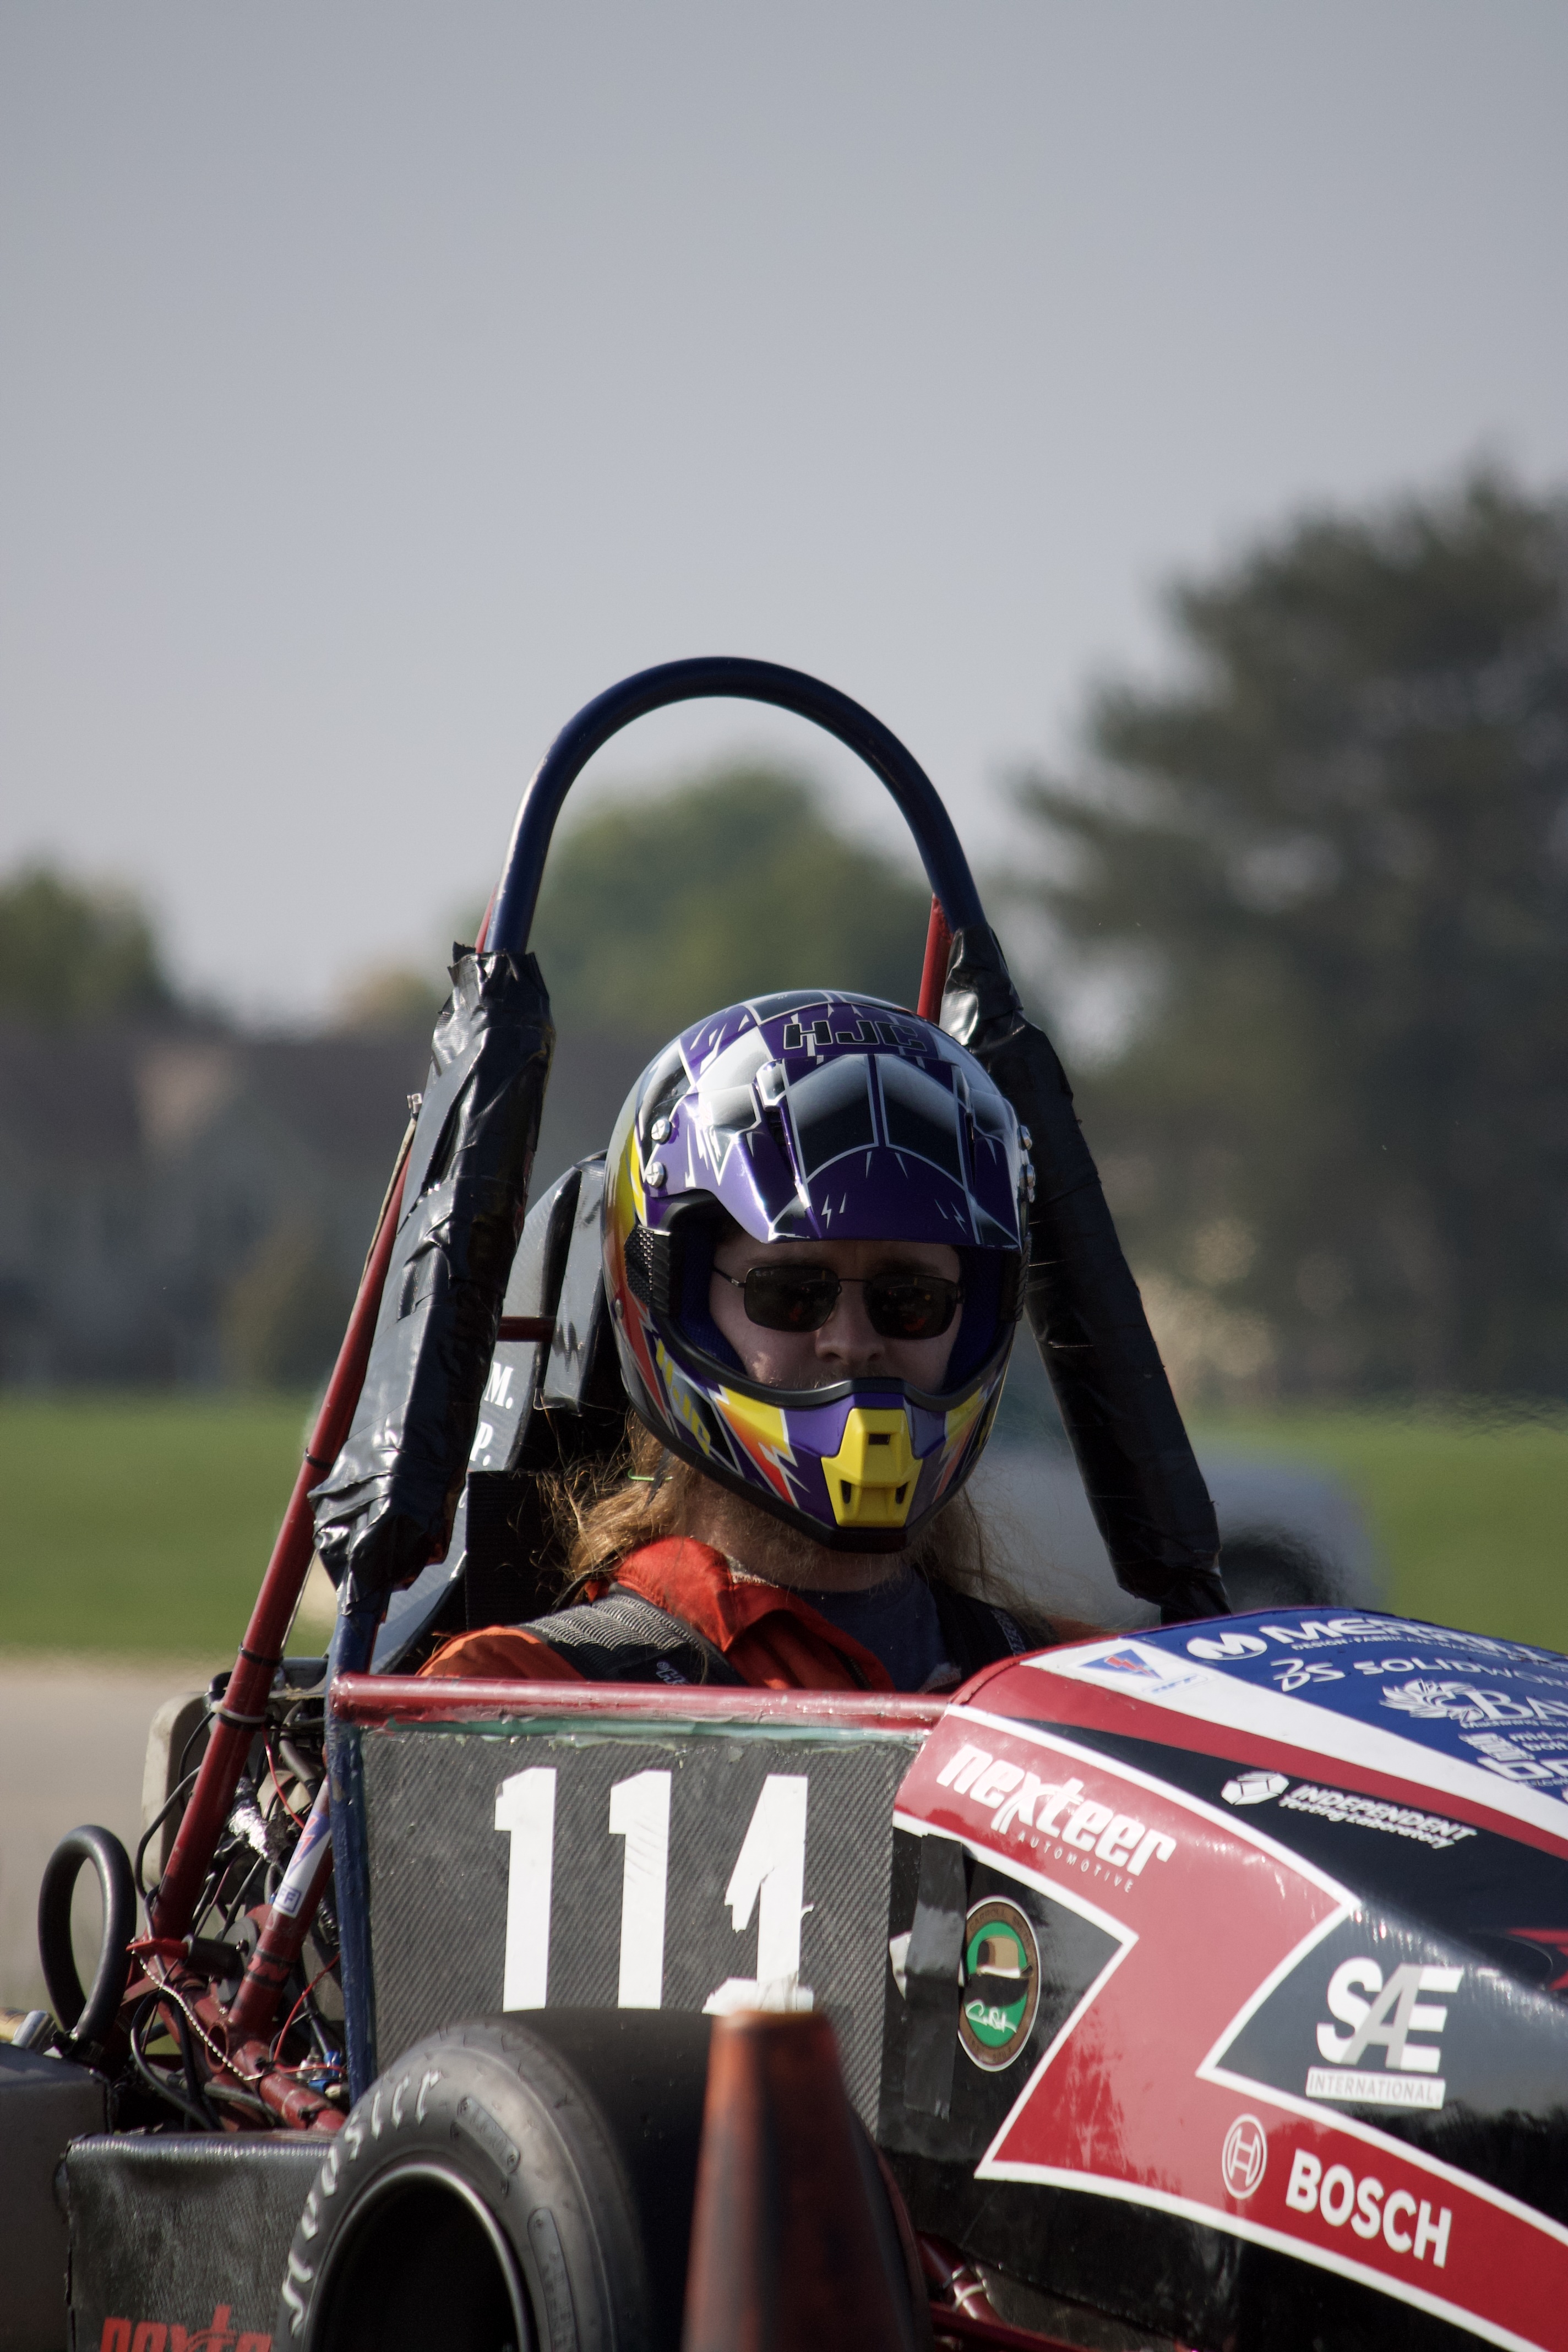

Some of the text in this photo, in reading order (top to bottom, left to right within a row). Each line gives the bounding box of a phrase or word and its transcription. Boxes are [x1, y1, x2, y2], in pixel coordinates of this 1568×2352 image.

[783, 1020, 928, 1052] HJC
[937, 1744, 1177, 1876] nexteer
[1291, 1784, 1478, 1841] INDEPENDENT
[1017, 1829, 1134, 1893] AUTOMOTIVE
[1316, 1957, 1463, 2073] SAE
[1309, 2073, 1435, 2102] INTERNATIONAL
[1286, 2148, 1451, 2268] BOSCH
